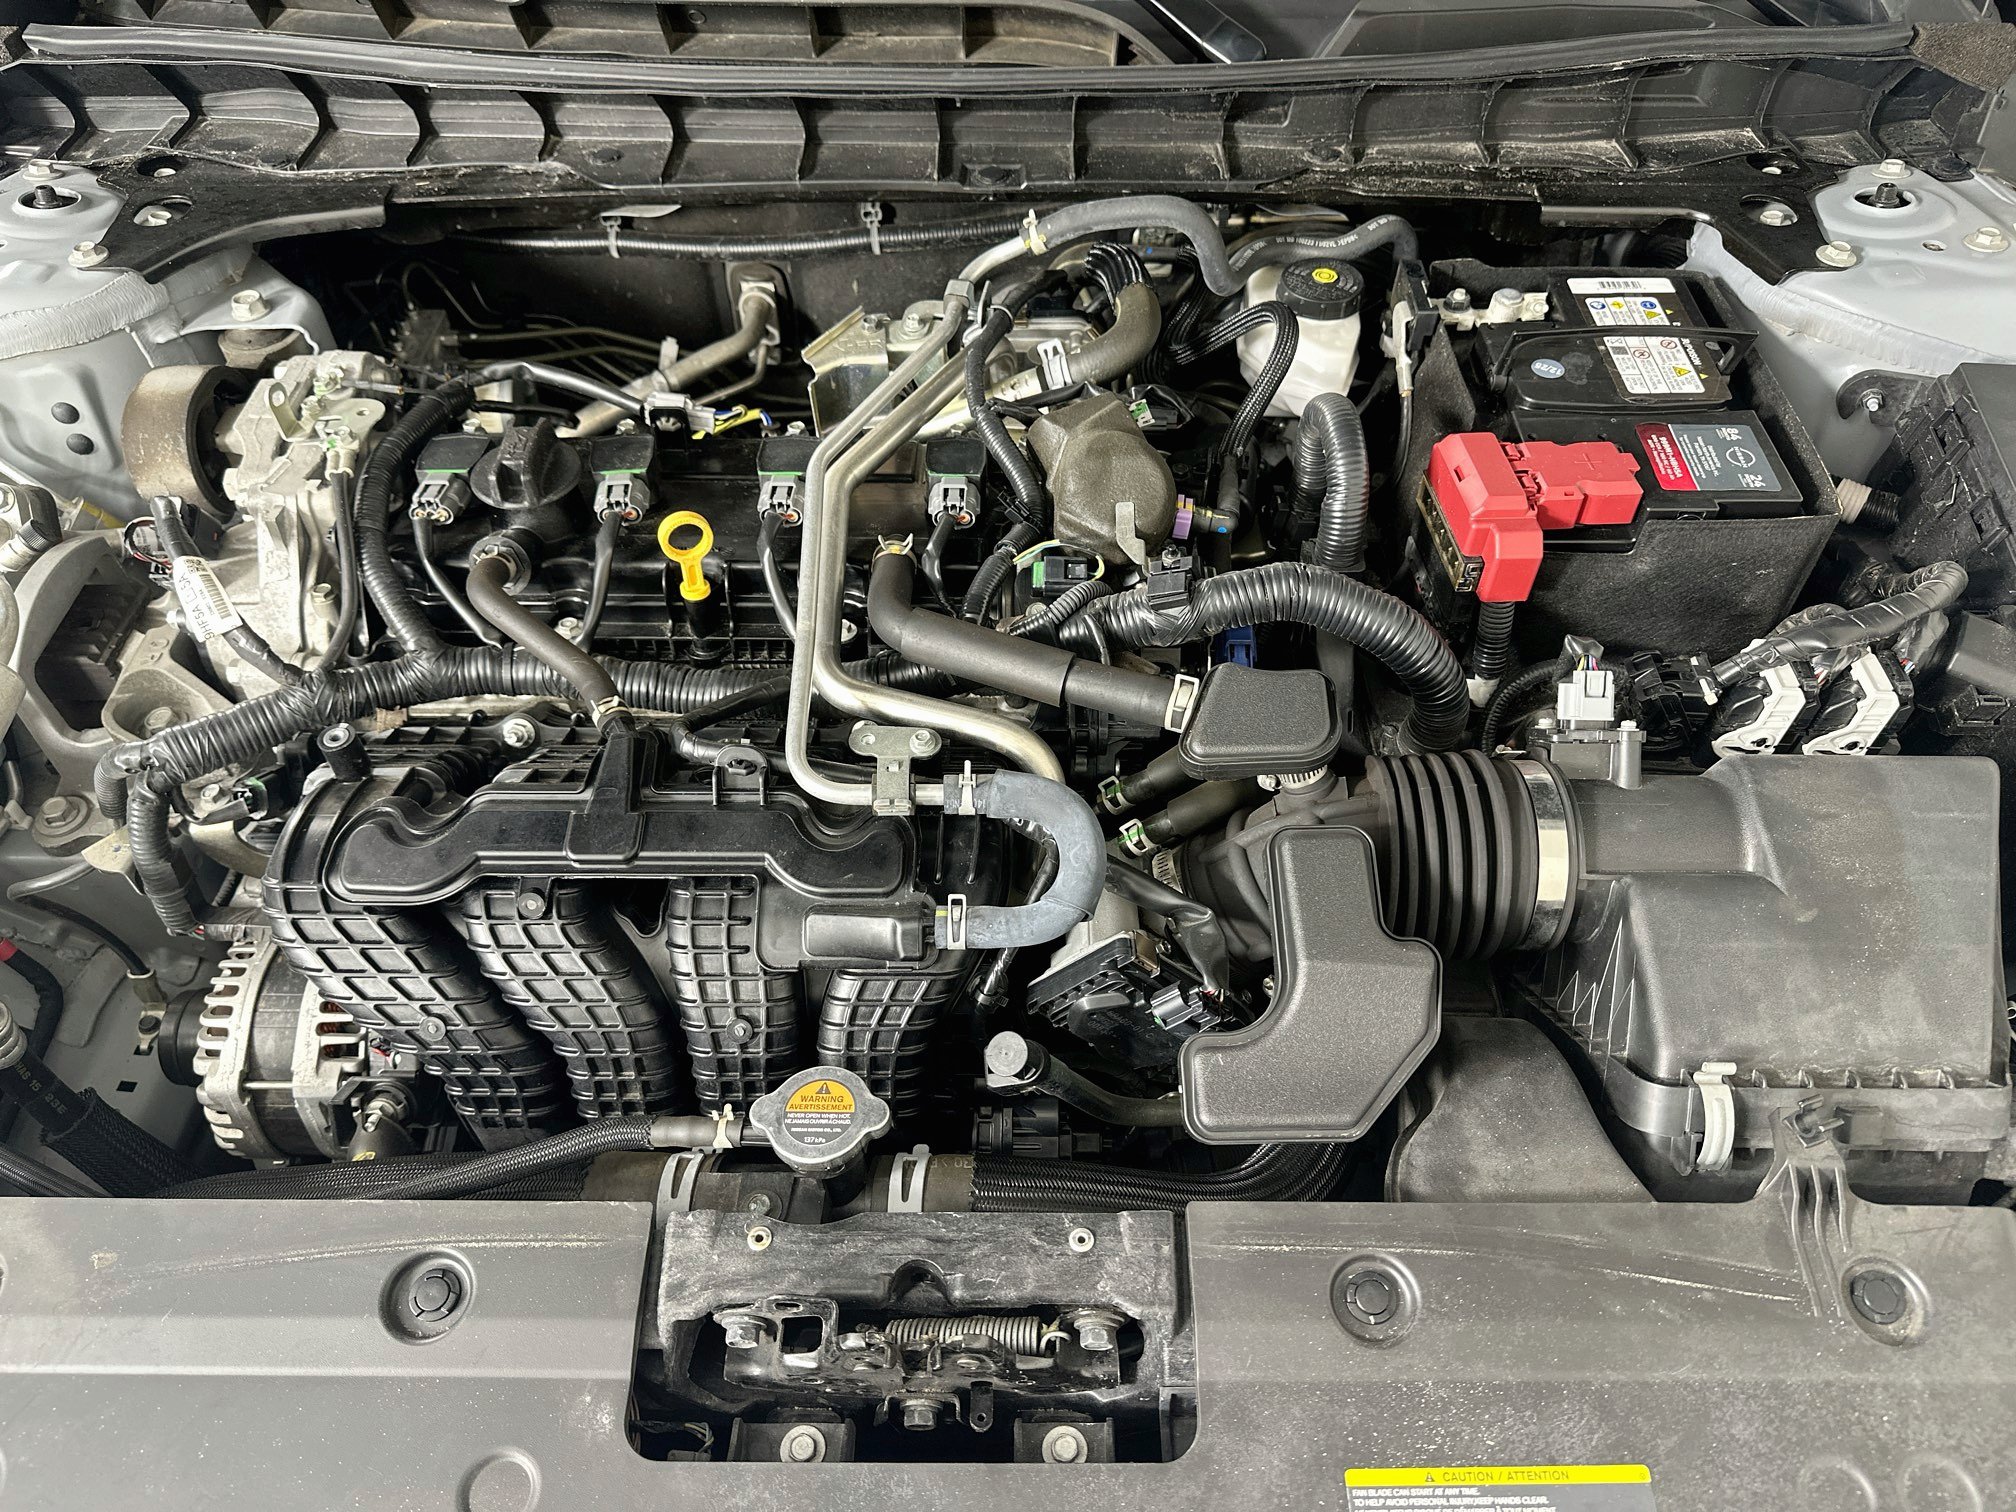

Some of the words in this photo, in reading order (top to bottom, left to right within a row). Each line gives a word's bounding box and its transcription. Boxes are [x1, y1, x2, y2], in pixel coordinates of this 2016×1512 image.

[1732, 446, 1748, 467] NISSAN
[800, 1095, 844, 1103] WARNING
[1442, 1472, 1494, 1482] CAUTION
[1507, 1470, 1569, 1481] ATTENTION
[1352, 1488, 1367, 1496] FAN
[1368, 1488, 1392, 1496] BLADE
[1393, 1488, 1410, 1496] CAN
[1353, 1498, 1364, 1506] TO
[1365, 1498, 1385, 1506] HELP
[1385, 1498, 1408, 1506] AVOID
[1495, 1496, 1521, 1504] HANDS
